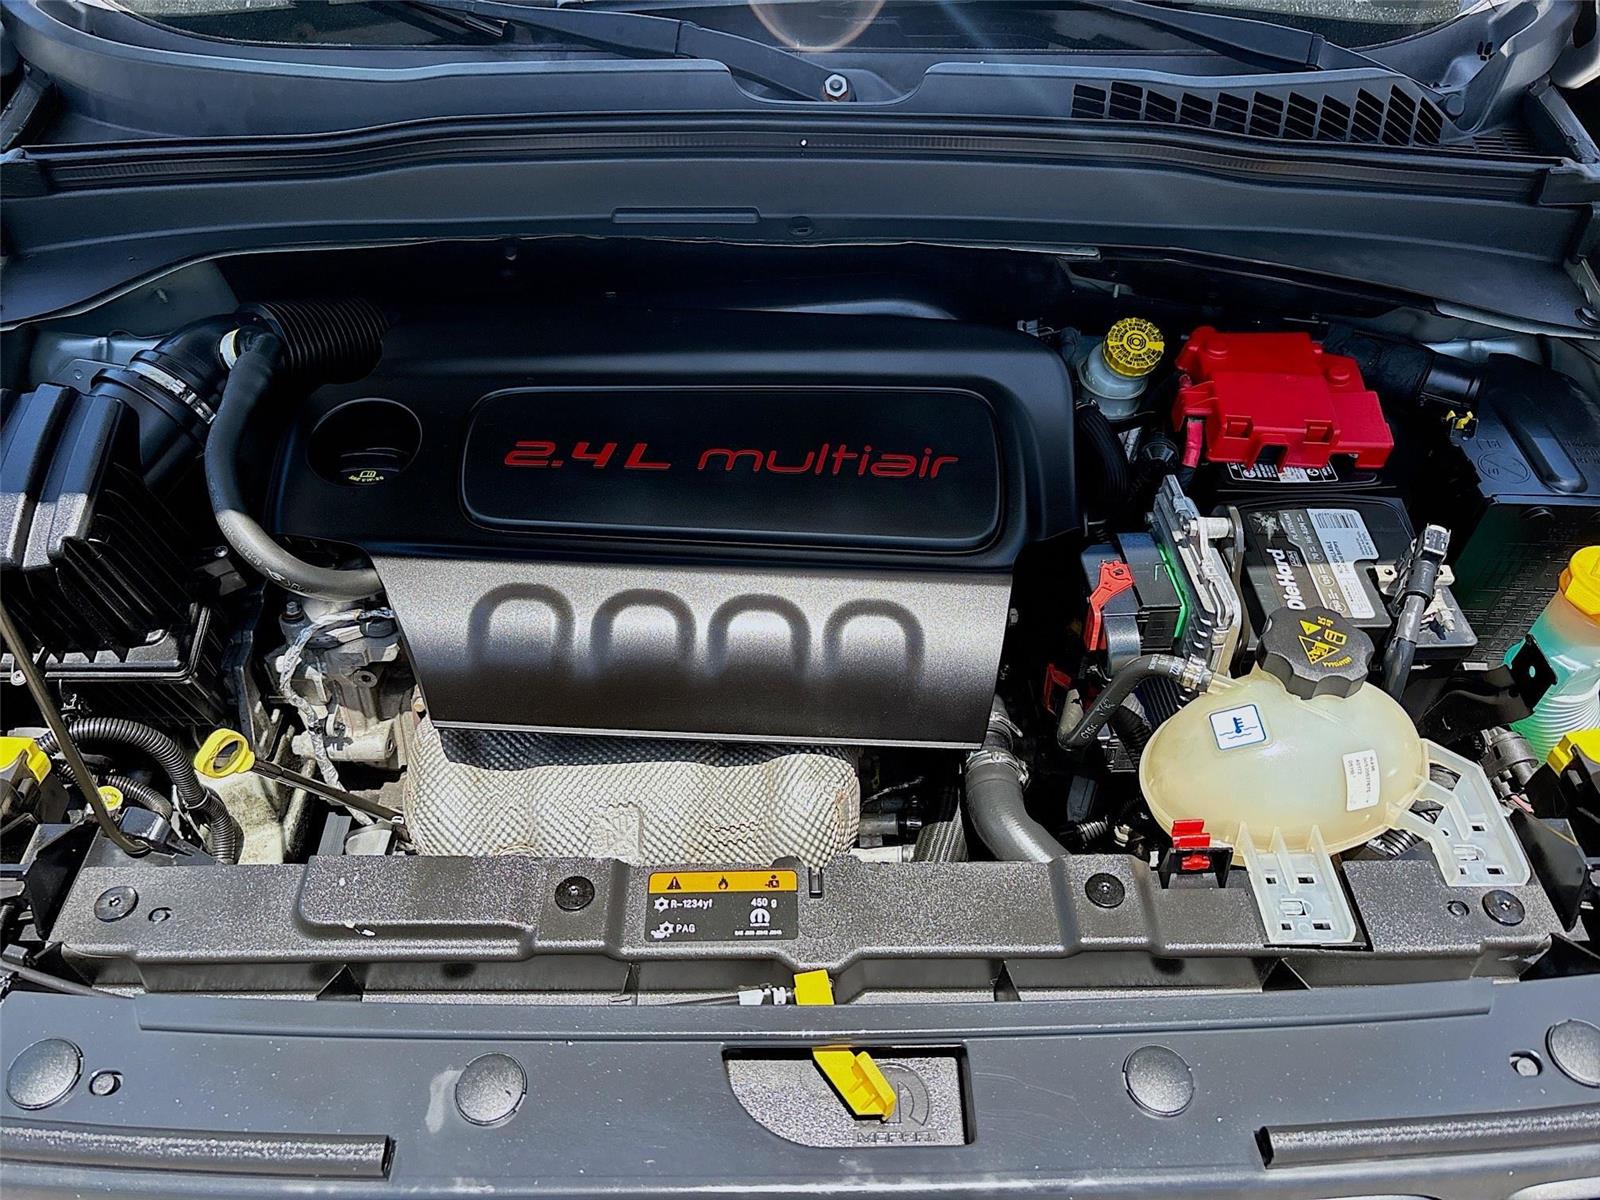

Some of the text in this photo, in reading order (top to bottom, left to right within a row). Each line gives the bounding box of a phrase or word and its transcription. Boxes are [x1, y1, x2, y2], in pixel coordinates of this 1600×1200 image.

[503, 440, 959, 479] 2.4L multiair
[1266, 548, 1307, 610] DieHard
[670, 897, 777, 909] R-1234yf 450 g
[675, 924, 696, 933] PAG
